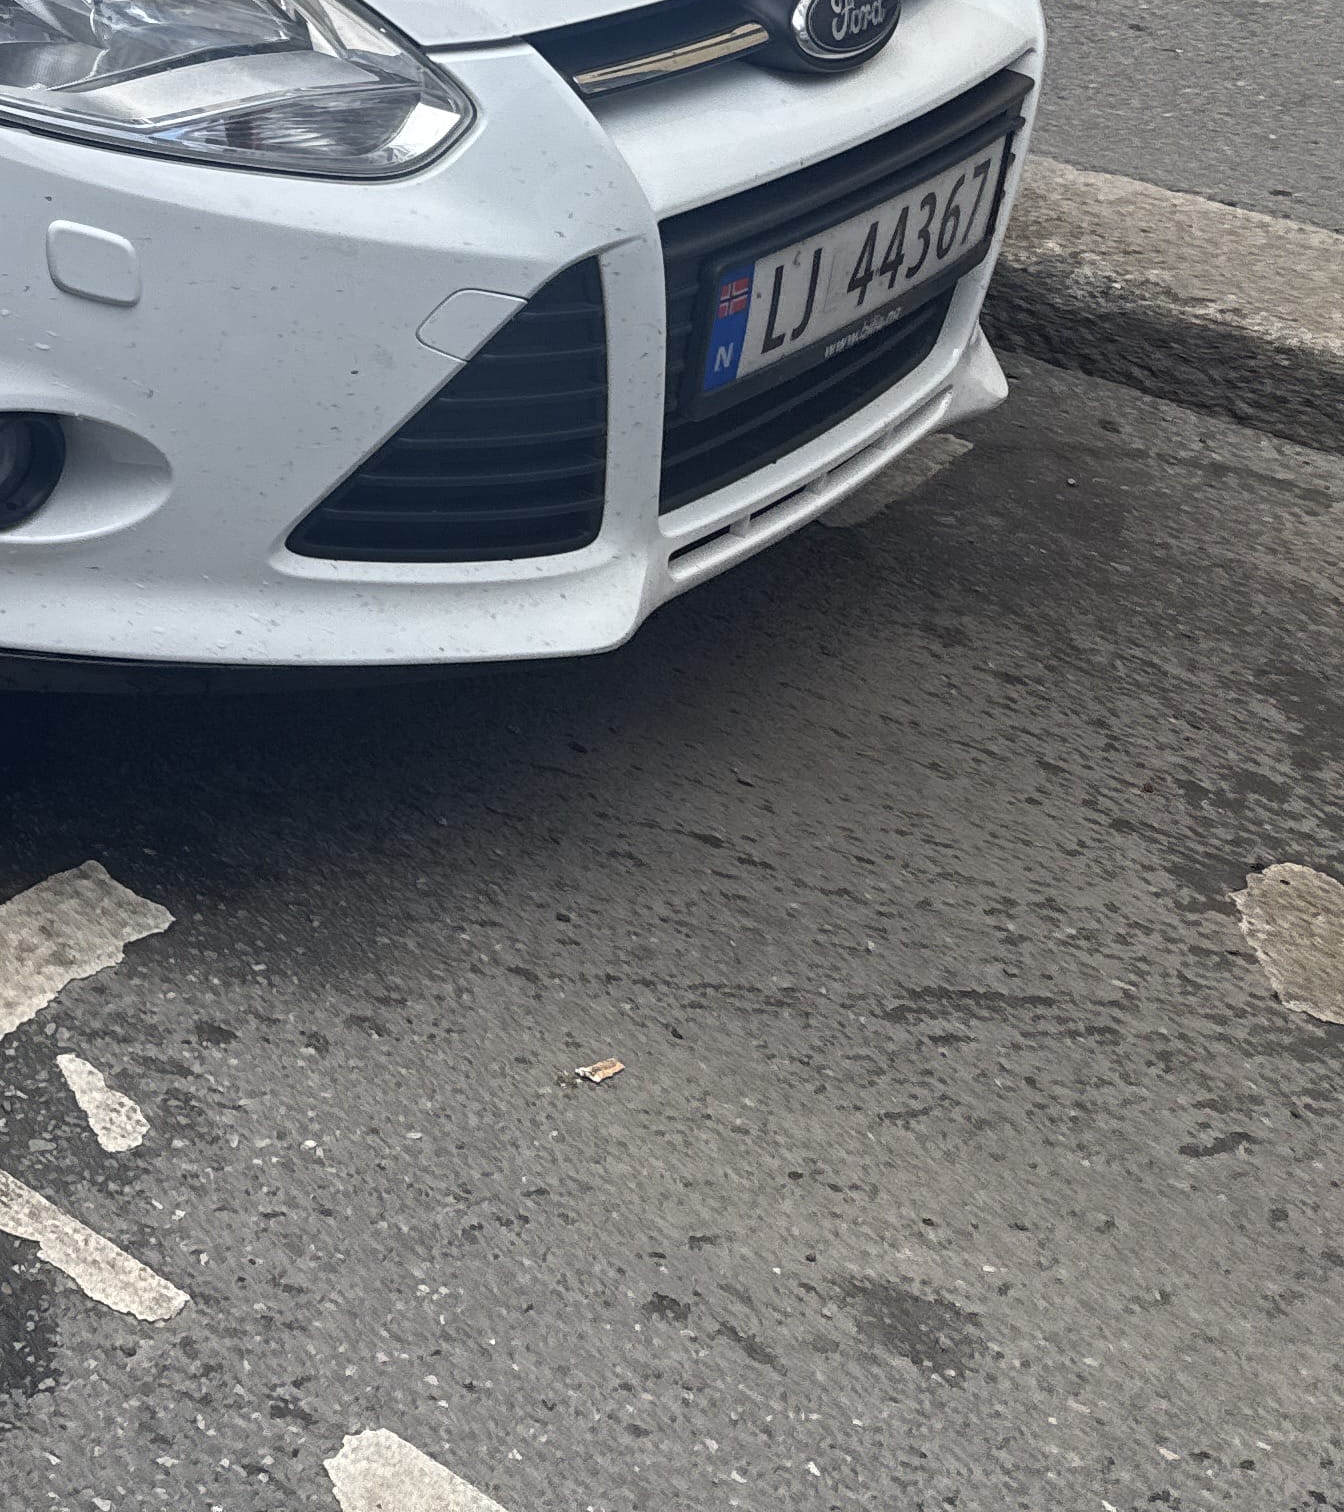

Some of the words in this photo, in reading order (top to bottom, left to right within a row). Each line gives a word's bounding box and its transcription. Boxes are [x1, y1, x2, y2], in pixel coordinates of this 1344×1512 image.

[761, 248, 823, 355] LJ
[847, 159, 991, 306] 44367
[714, 342, 734, 372] N
